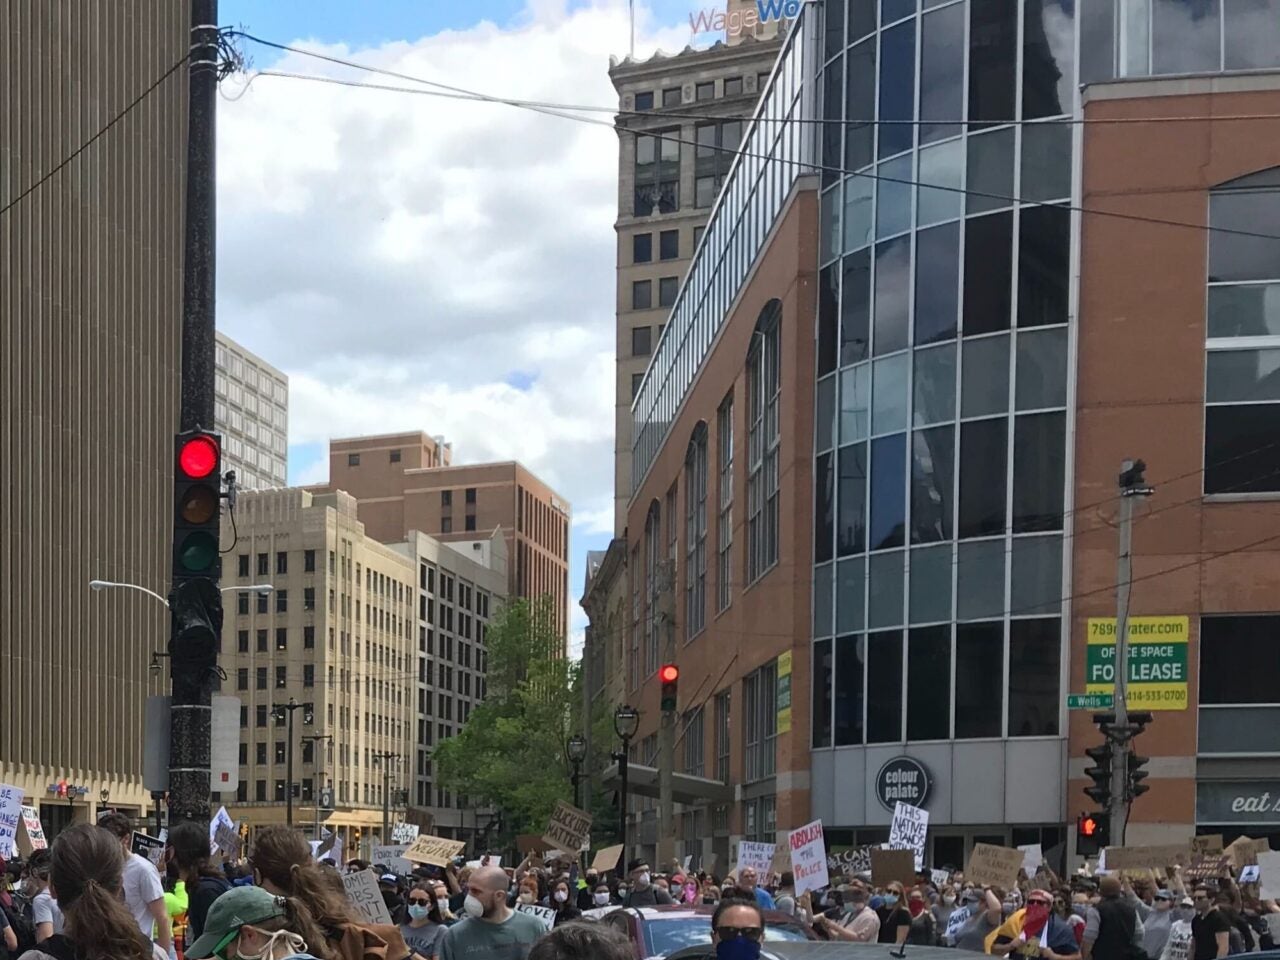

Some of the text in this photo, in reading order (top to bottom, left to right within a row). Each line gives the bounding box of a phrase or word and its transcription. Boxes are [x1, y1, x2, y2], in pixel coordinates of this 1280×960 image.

[1101, 646, 1174, 658] OFCE SPACE
[1092, 663, 1181, 681] FO LEASE
[885, 768, 919, 783] colour
[1, 789, 11, 799] BE
[885, 784, 919, 801] palate
[1232, 792, 1271, 812] eat
[898, 804, 920, 820] THIS
[893, 817, 926, 834] NATIVE
[790, 823, 822, 850] ABOLISH
[891, 830, 925, 848] STANDS
[743, 843, 765, 851] THERE
[800, 847, 814, 861] THE
[345, 871, 369, 889] OME
